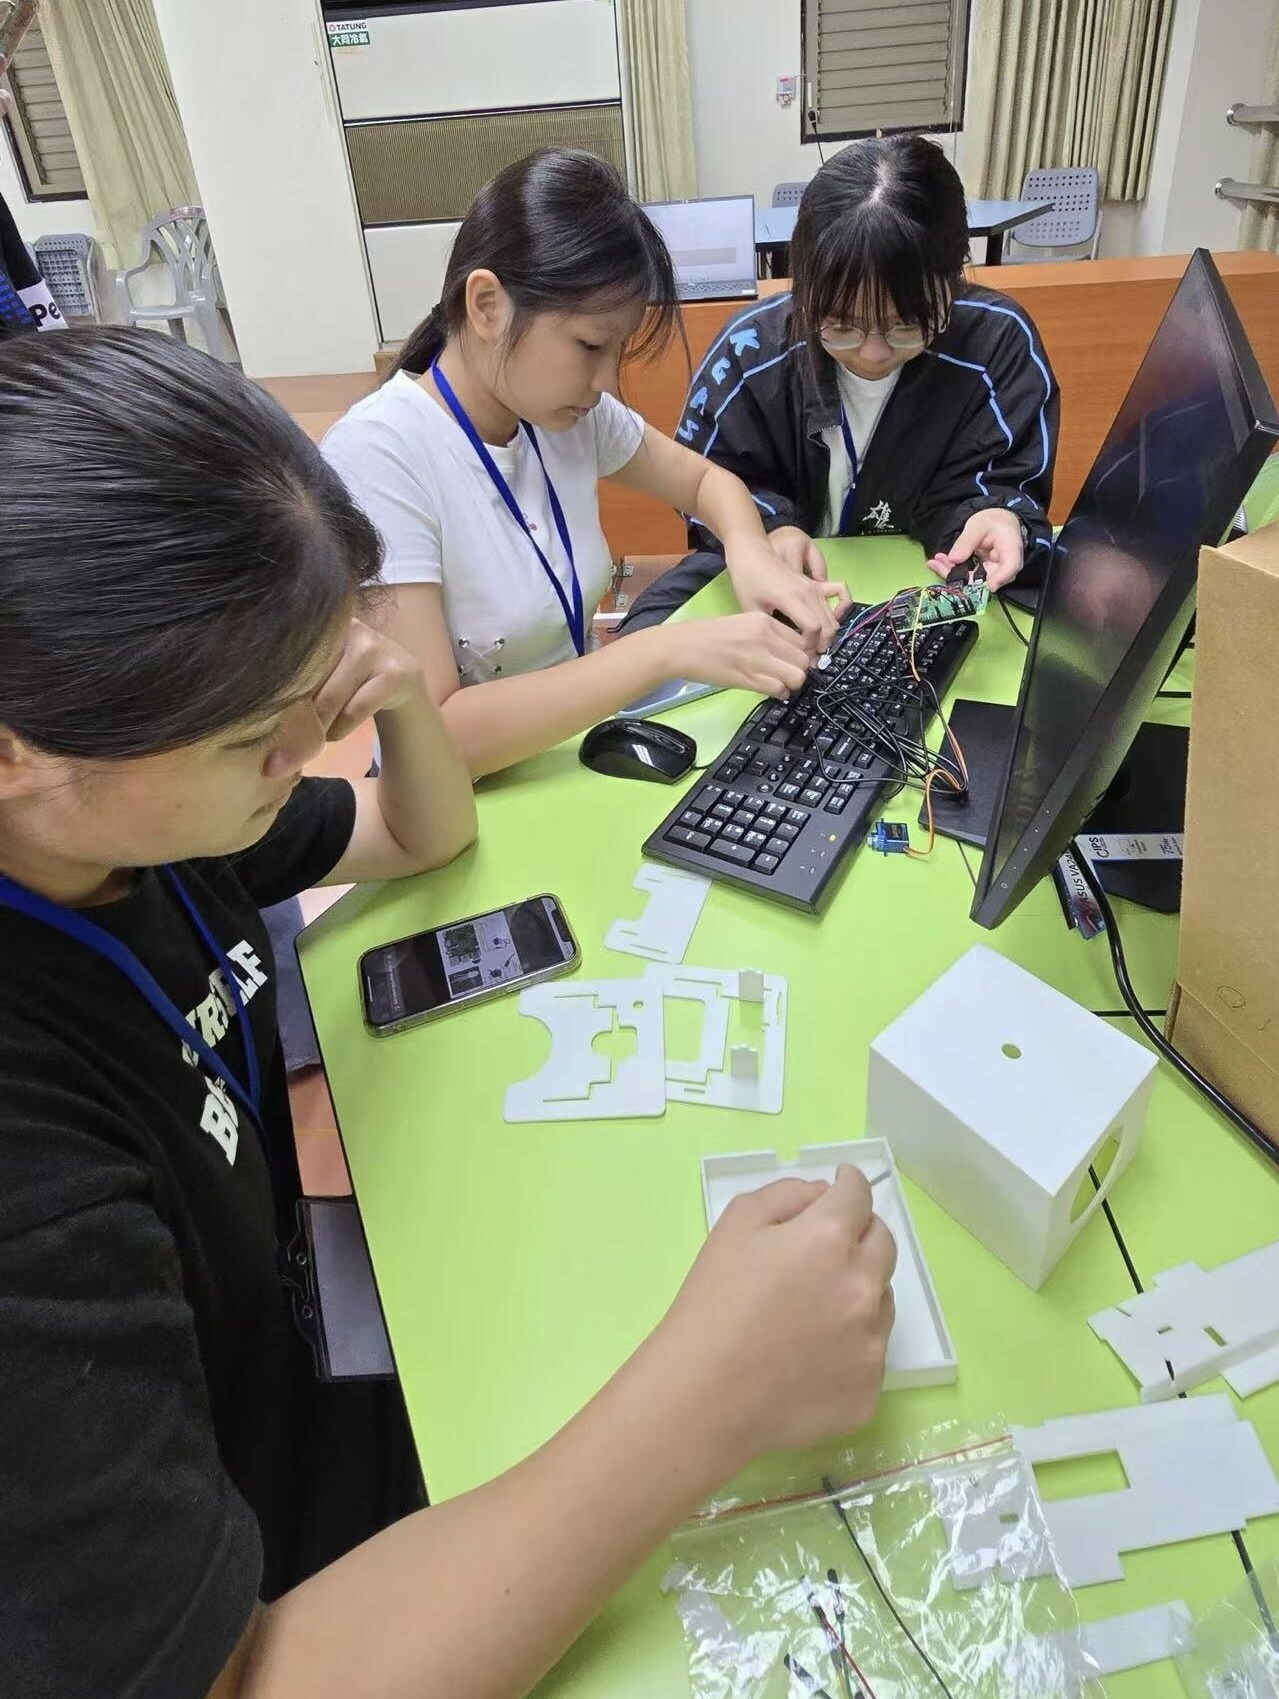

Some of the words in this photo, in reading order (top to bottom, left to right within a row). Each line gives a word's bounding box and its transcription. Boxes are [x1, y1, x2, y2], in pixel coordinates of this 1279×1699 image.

[336, 22, 367, 31] TATUNG
[331, 33, 369, 47] 大同冷氣
